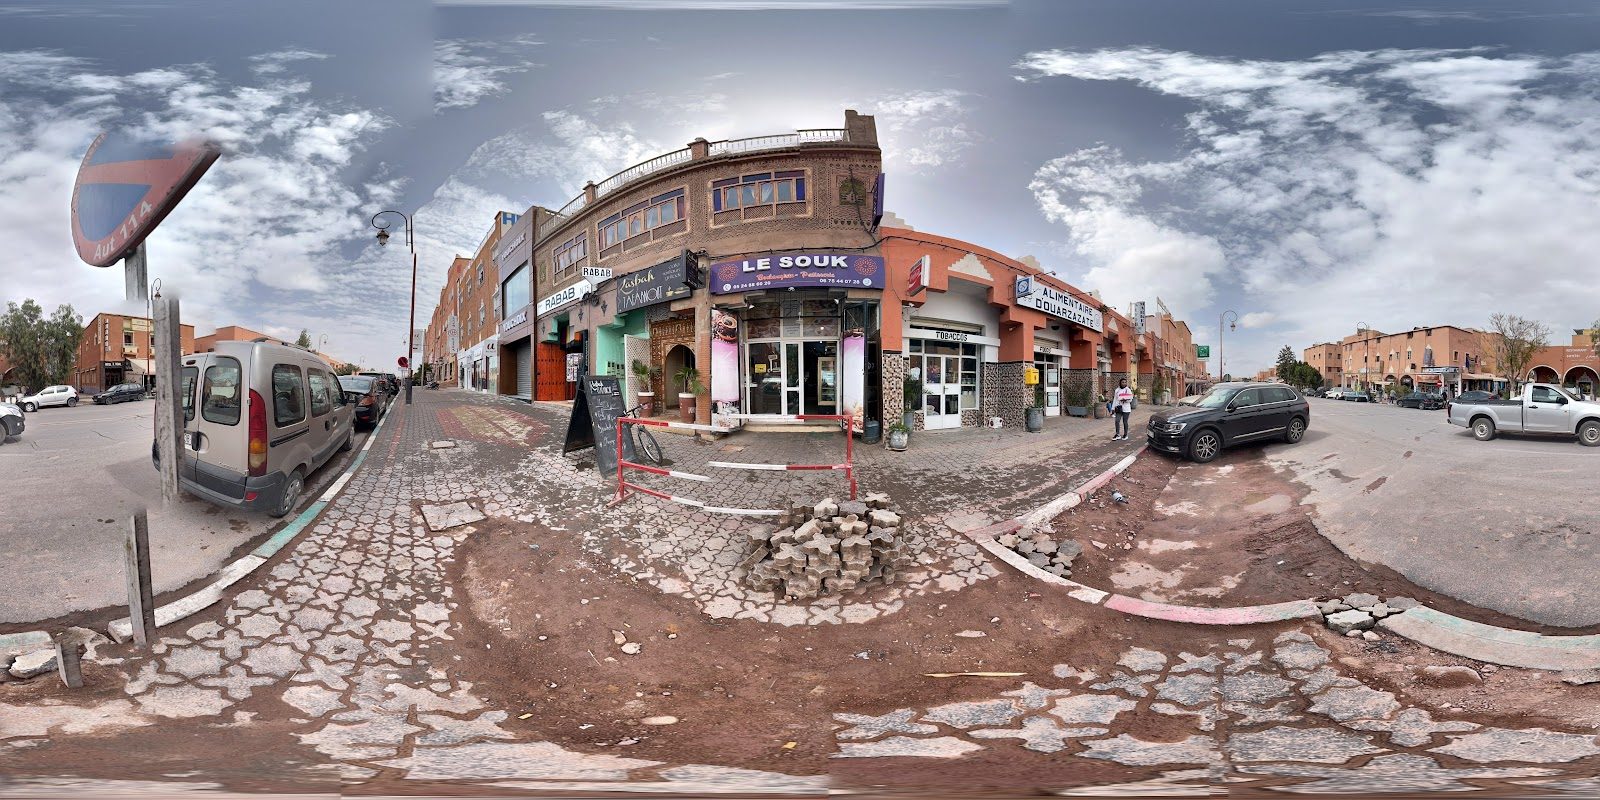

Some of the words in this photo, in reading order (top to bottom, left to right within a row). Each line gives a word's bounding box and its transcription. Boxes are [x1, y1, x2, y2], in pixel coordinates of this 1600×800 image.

[93, 236, 116, 260] Aut
[120, 201, 152, 240] 114
[583, 267, 611, 277] RABAB
[742, 257, 771, 273] LE
[779, 256, 849, 268] SOUK
[545, 287, 575, 310] RABAB
[1043, 287, 1093, 317] ALIMENTAIRE
[1036, 297, 1094, 327] D'OUARZAZATE
